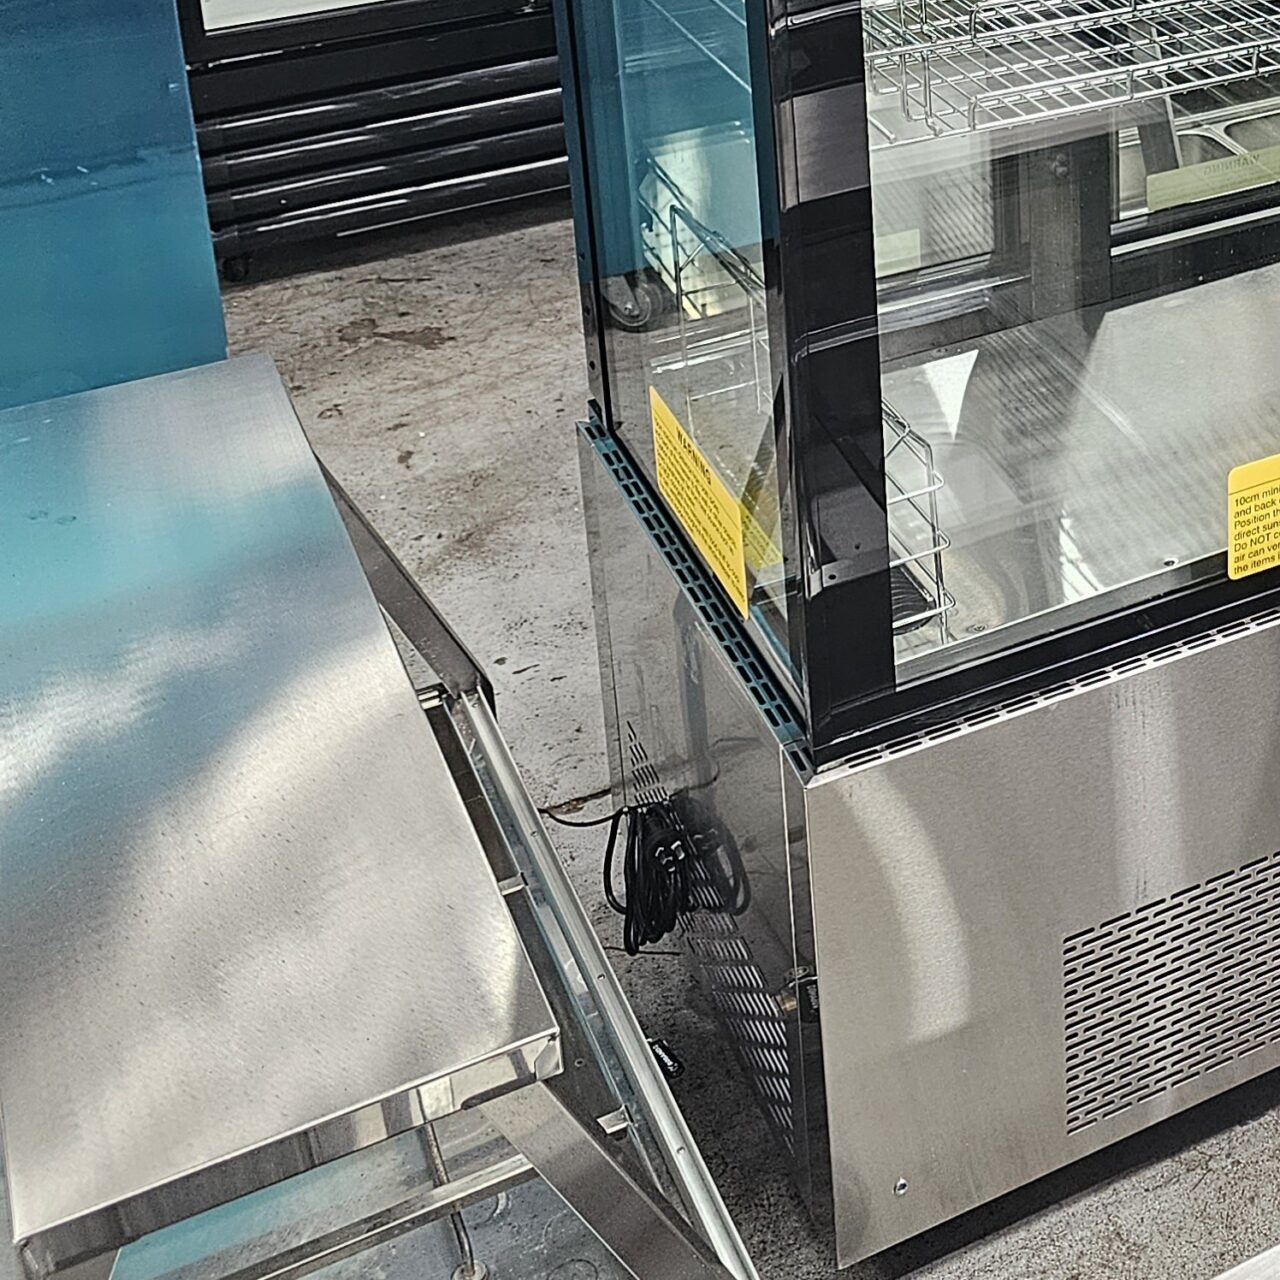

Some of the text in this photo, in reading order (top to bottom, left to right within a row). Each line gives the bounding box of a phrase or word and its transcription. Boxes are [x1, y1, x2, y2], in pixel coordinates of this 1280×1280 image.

[676, 426, 711, 486] WARNING
[1234, 505, 1252, 519] and
[1254, 497, 1277, 512] back
[1235, 492, 1260, 507] 10cm
[1234, 511, 1271, 530] Position
[1234, 526, 1260, 542] direct
[1234, 541, 1248, 553] Do
[1250, 532, 1272, 548] NOT
[1234, 552, 1245, 564] air
[1247, 547, 1265, 559] can
[1234, 563, 1248, 575] the
[1250, 553, 1276, 568] items
